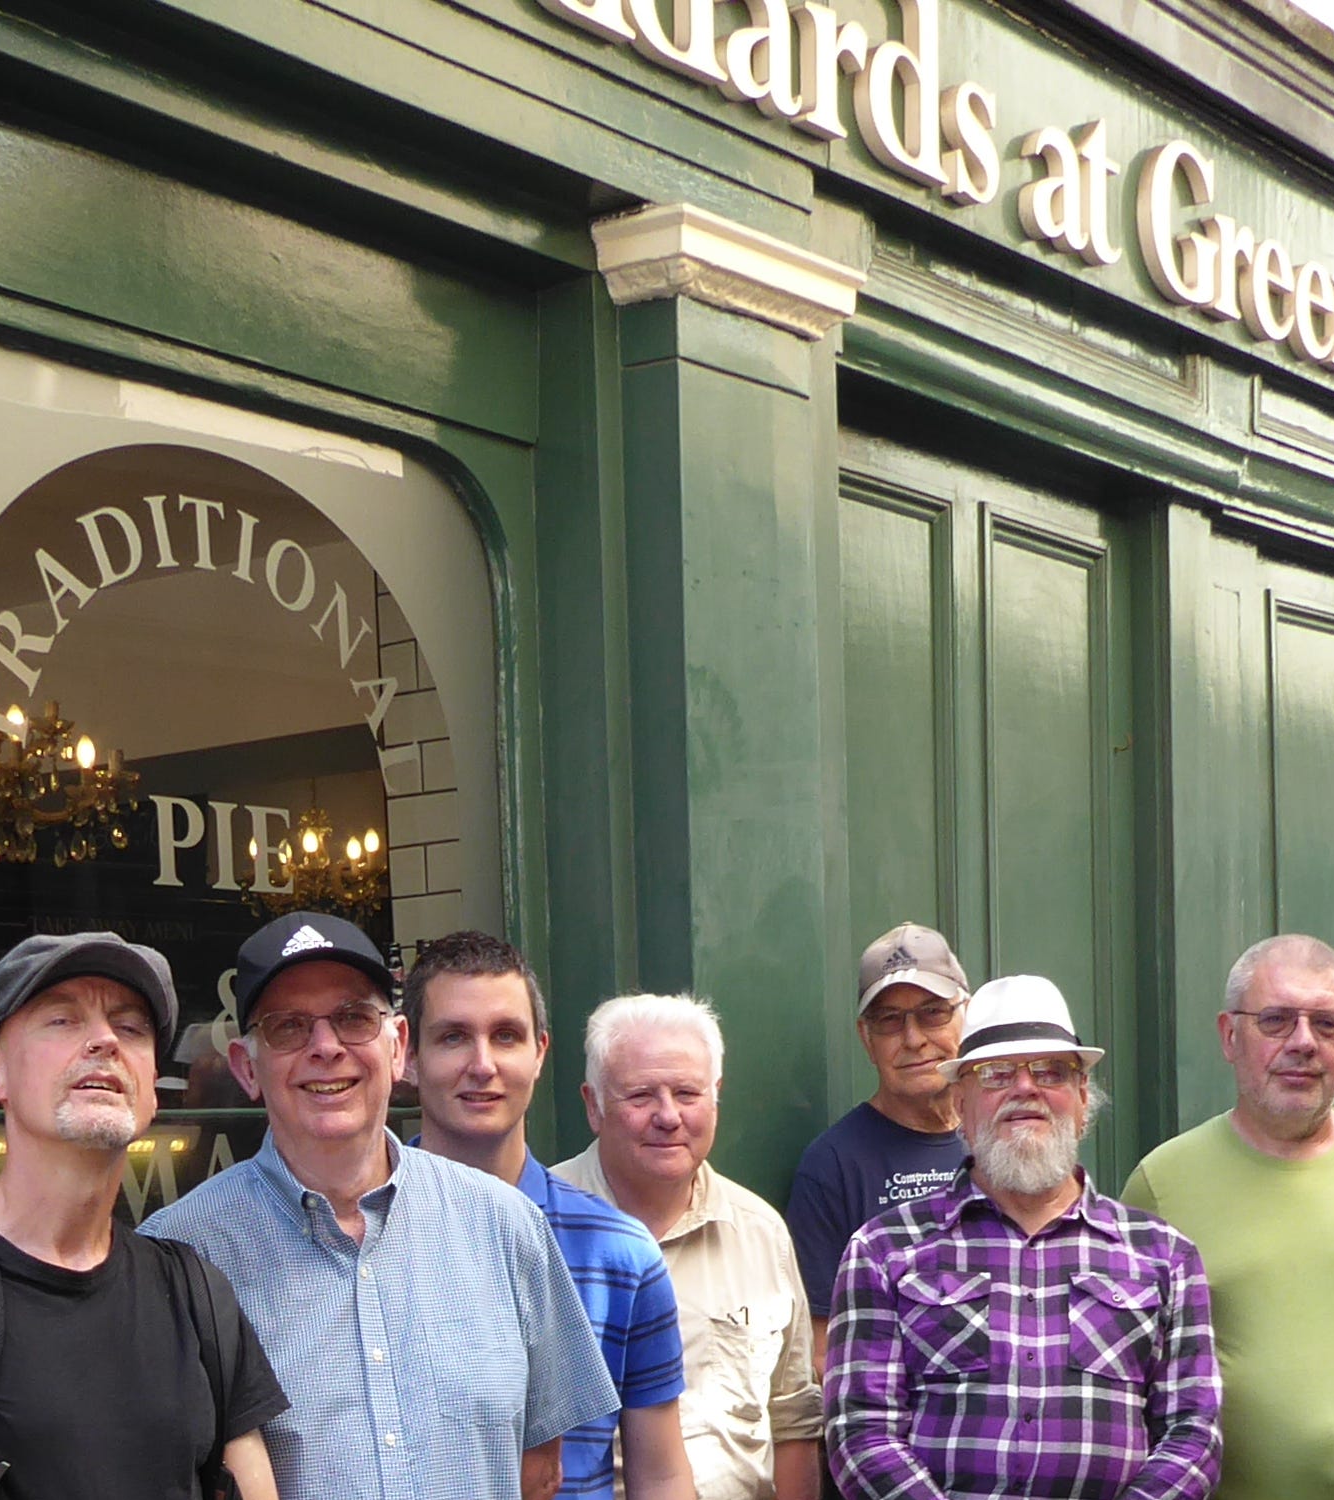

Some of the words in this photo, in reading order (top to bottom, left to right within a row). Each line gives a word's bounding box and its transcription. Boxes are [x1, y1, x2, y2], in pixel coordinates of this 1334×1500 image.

[1018, 117, 1122, 266] at
[148, 794, 296, 896] PIE
[893, 1168, 958, 1186] Comprehens
